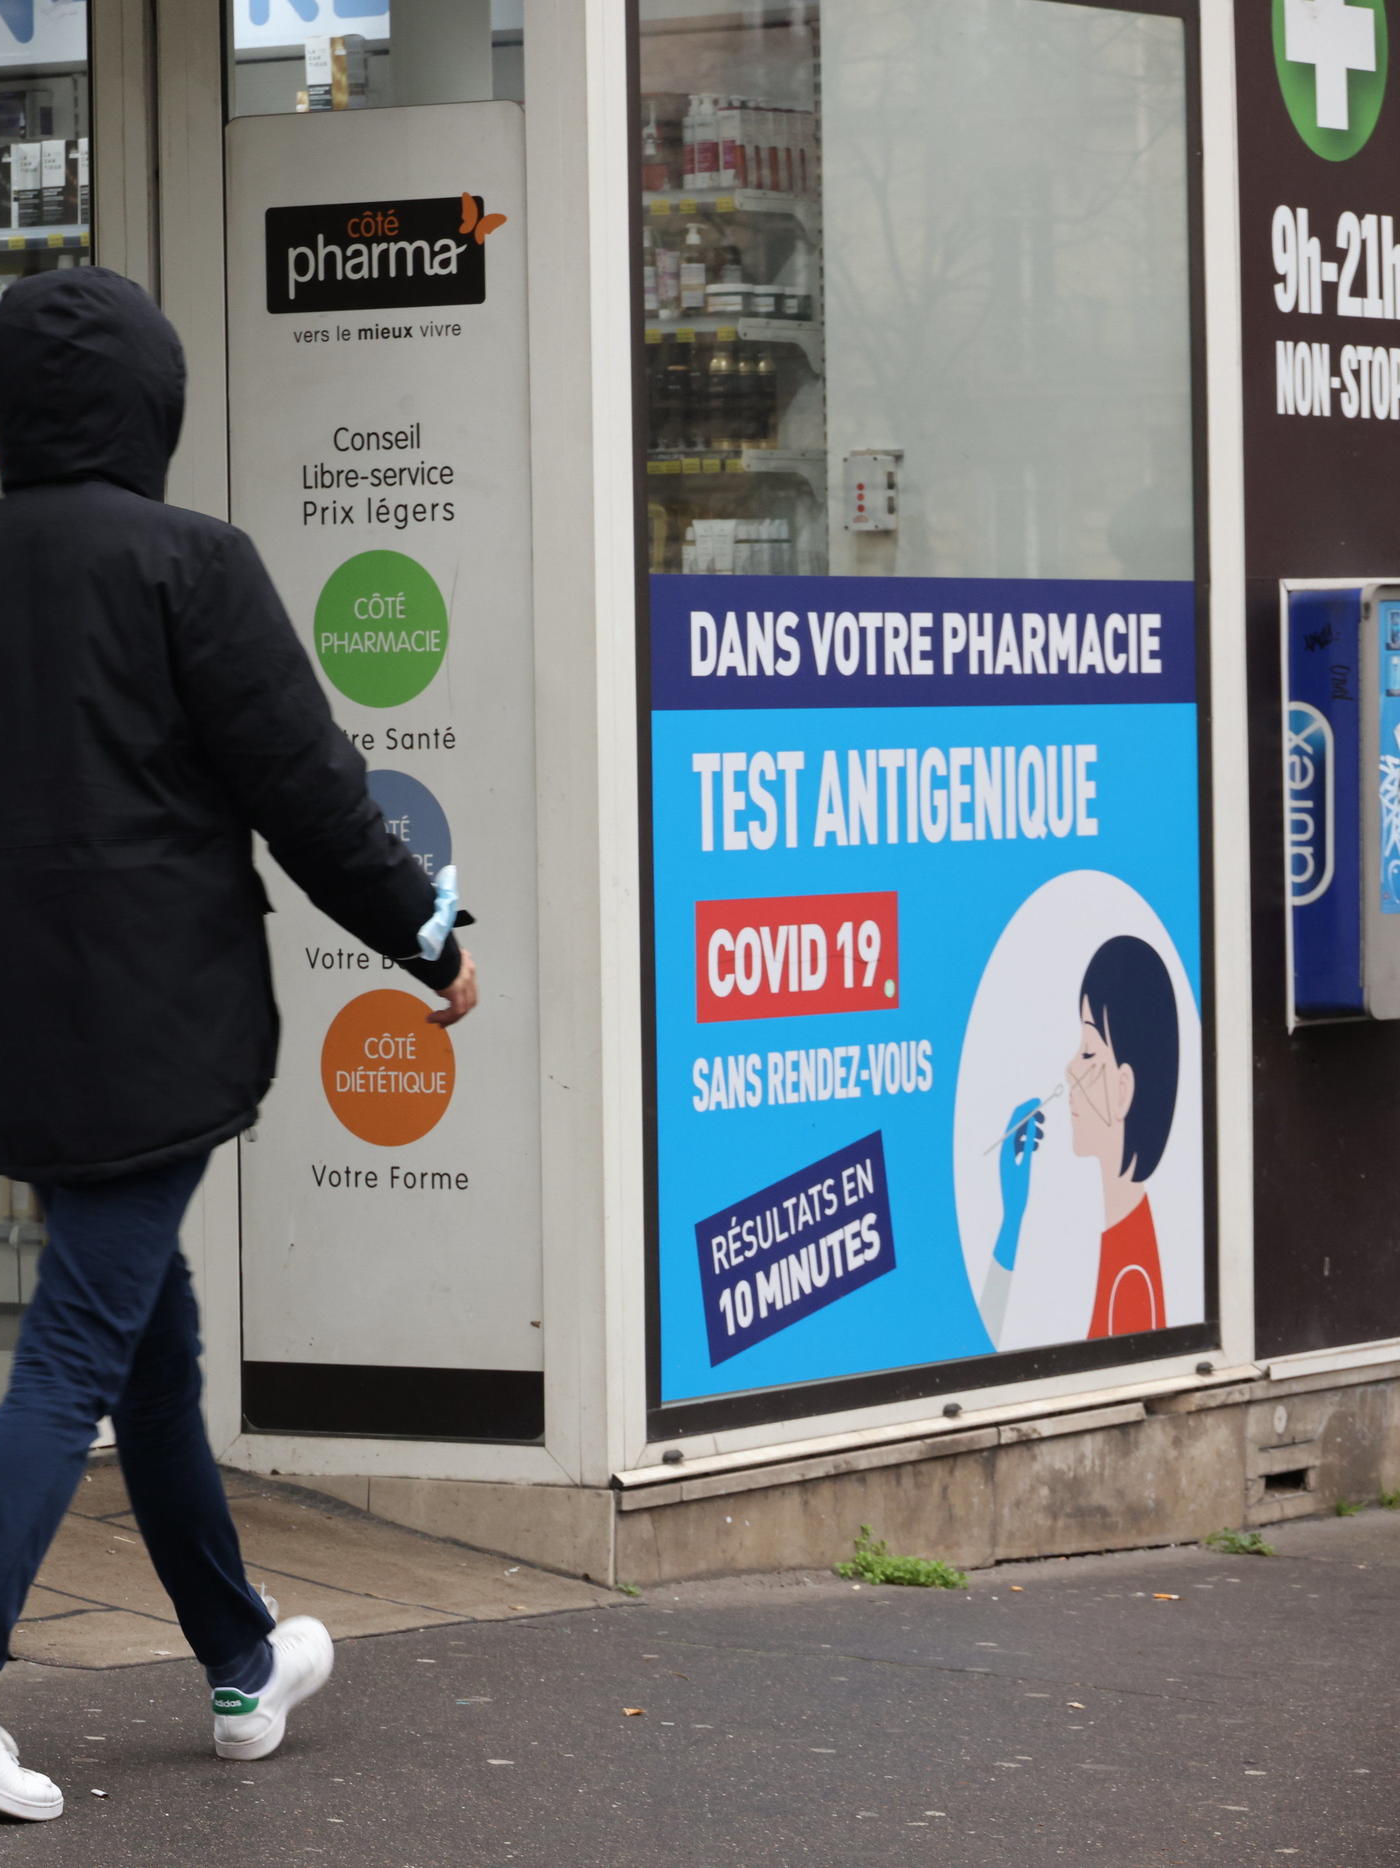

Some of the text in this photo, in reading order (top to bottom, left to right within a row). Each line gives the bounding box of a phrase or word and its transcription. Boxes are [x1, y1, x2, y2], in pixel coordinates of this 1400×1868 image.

[347, 209, 400, 238] côté
[288, 233, 468, 300] pharma
[1271, 204, 1400, 320] 9h-21h
[293, 321, 462, 343] vers le mieux vivre
[334, 423, 420, 451] Conseil
[303, 461, 453, 489] Libre-service
[304, 498, 454, 529] Prix légers
[354, 592, 406, 619] CÔTÉ
[322, 630, 440, 653] PHARMACIE
[691, 612, 1161, 676] DANS VOTRE PHARMACIE
[386, 727, 455, 750] Santé
[692, 744, 1098, 851] TEST ANTIGENIQUE
[305, 948, 369, 970] Votre
[708, 924, 827, 997] COVID
[364, 1033, 416, 1059] CÔTÉ
[337, 1066, 446, 1093] DIÉTÉTIQUE
[693, 1040, 932, 1112] SANS RENDEZ-VOUS
[312, 1165, 468, 1190] Votre Forme
[712, 1159, 874, 1275] RÉSULTATS EN
[720, 1213, 881, 1335] 10 MINUTES
